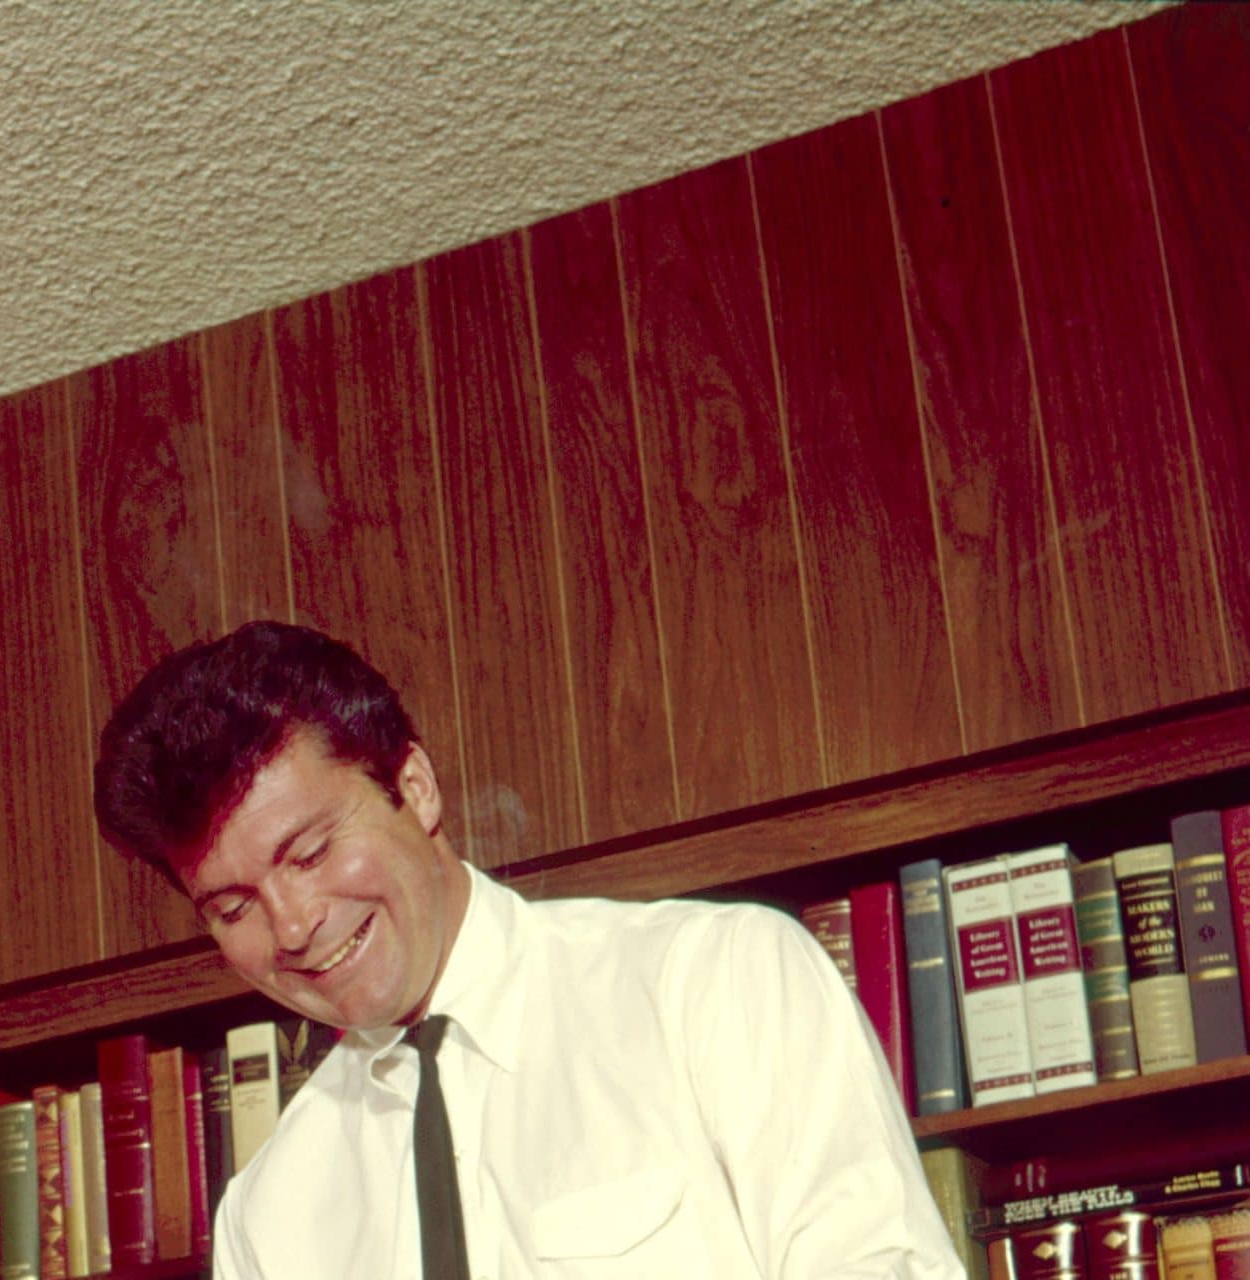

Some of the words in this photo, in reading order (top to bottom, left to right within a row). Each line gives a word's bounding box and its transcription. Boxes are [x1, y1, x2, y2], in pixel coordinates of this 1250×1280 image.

[1127, 900, 1170, 916] MAKERS
[1029, 917, 1060, 930] Library
[970, 930, 1001, 943] Library
[1030, 933, 1039, 942] of
[1040, 929, 1064, 940] Great
[1129, 928, 1175, 945] MODERN
[971, 946, 980, 955] of
[980, 942, 1004, 953] Great
[1030, 941, 1069, 954] American
[1134, 943, 1174, 958] WORLD
[970, 955, 1008, 967] American
[1034, 955, 1066, 967] Writing
[974, 967, 1006, 979] Writing
